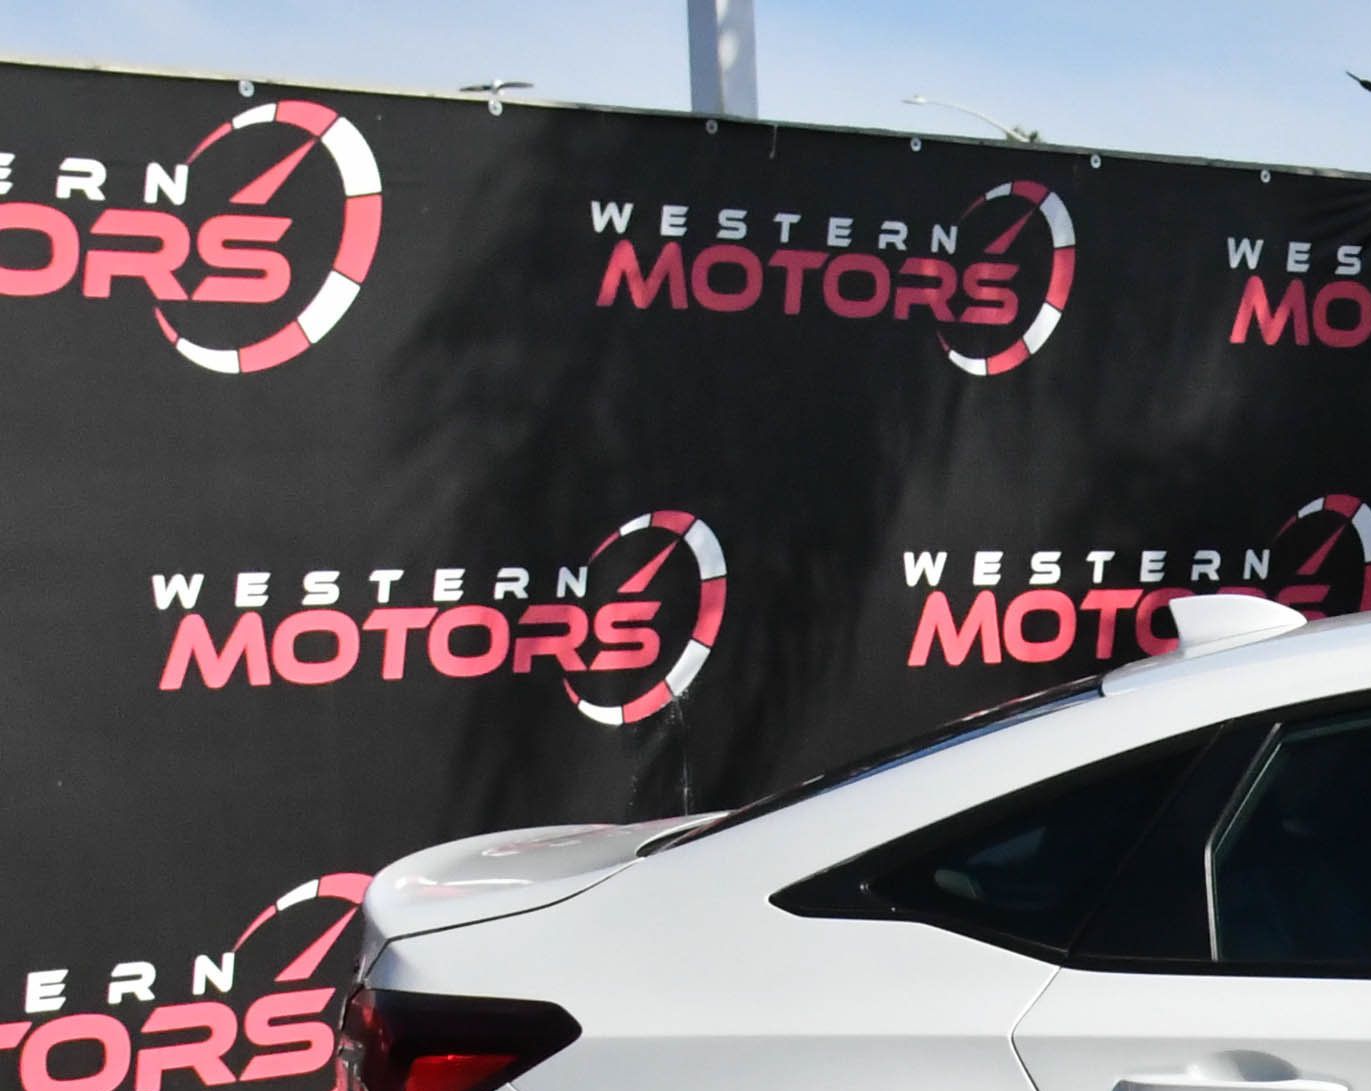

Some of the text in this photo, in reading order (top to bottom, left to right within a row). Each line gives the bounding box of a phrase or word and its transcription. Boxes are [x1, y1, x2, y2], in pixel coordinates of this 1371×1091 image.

[591, 200, 958, 255] WESTERN
[596, 239, 1020, 325] MOTORS
[152, 566, 589, 611] WESTERN
[903, 548, 1271, 588] WESTERN
[158, 600, 663, 691] MOTORS
[907, 585, 1331, 667] MOTO
[25, 952, 236, 1014] ERN
